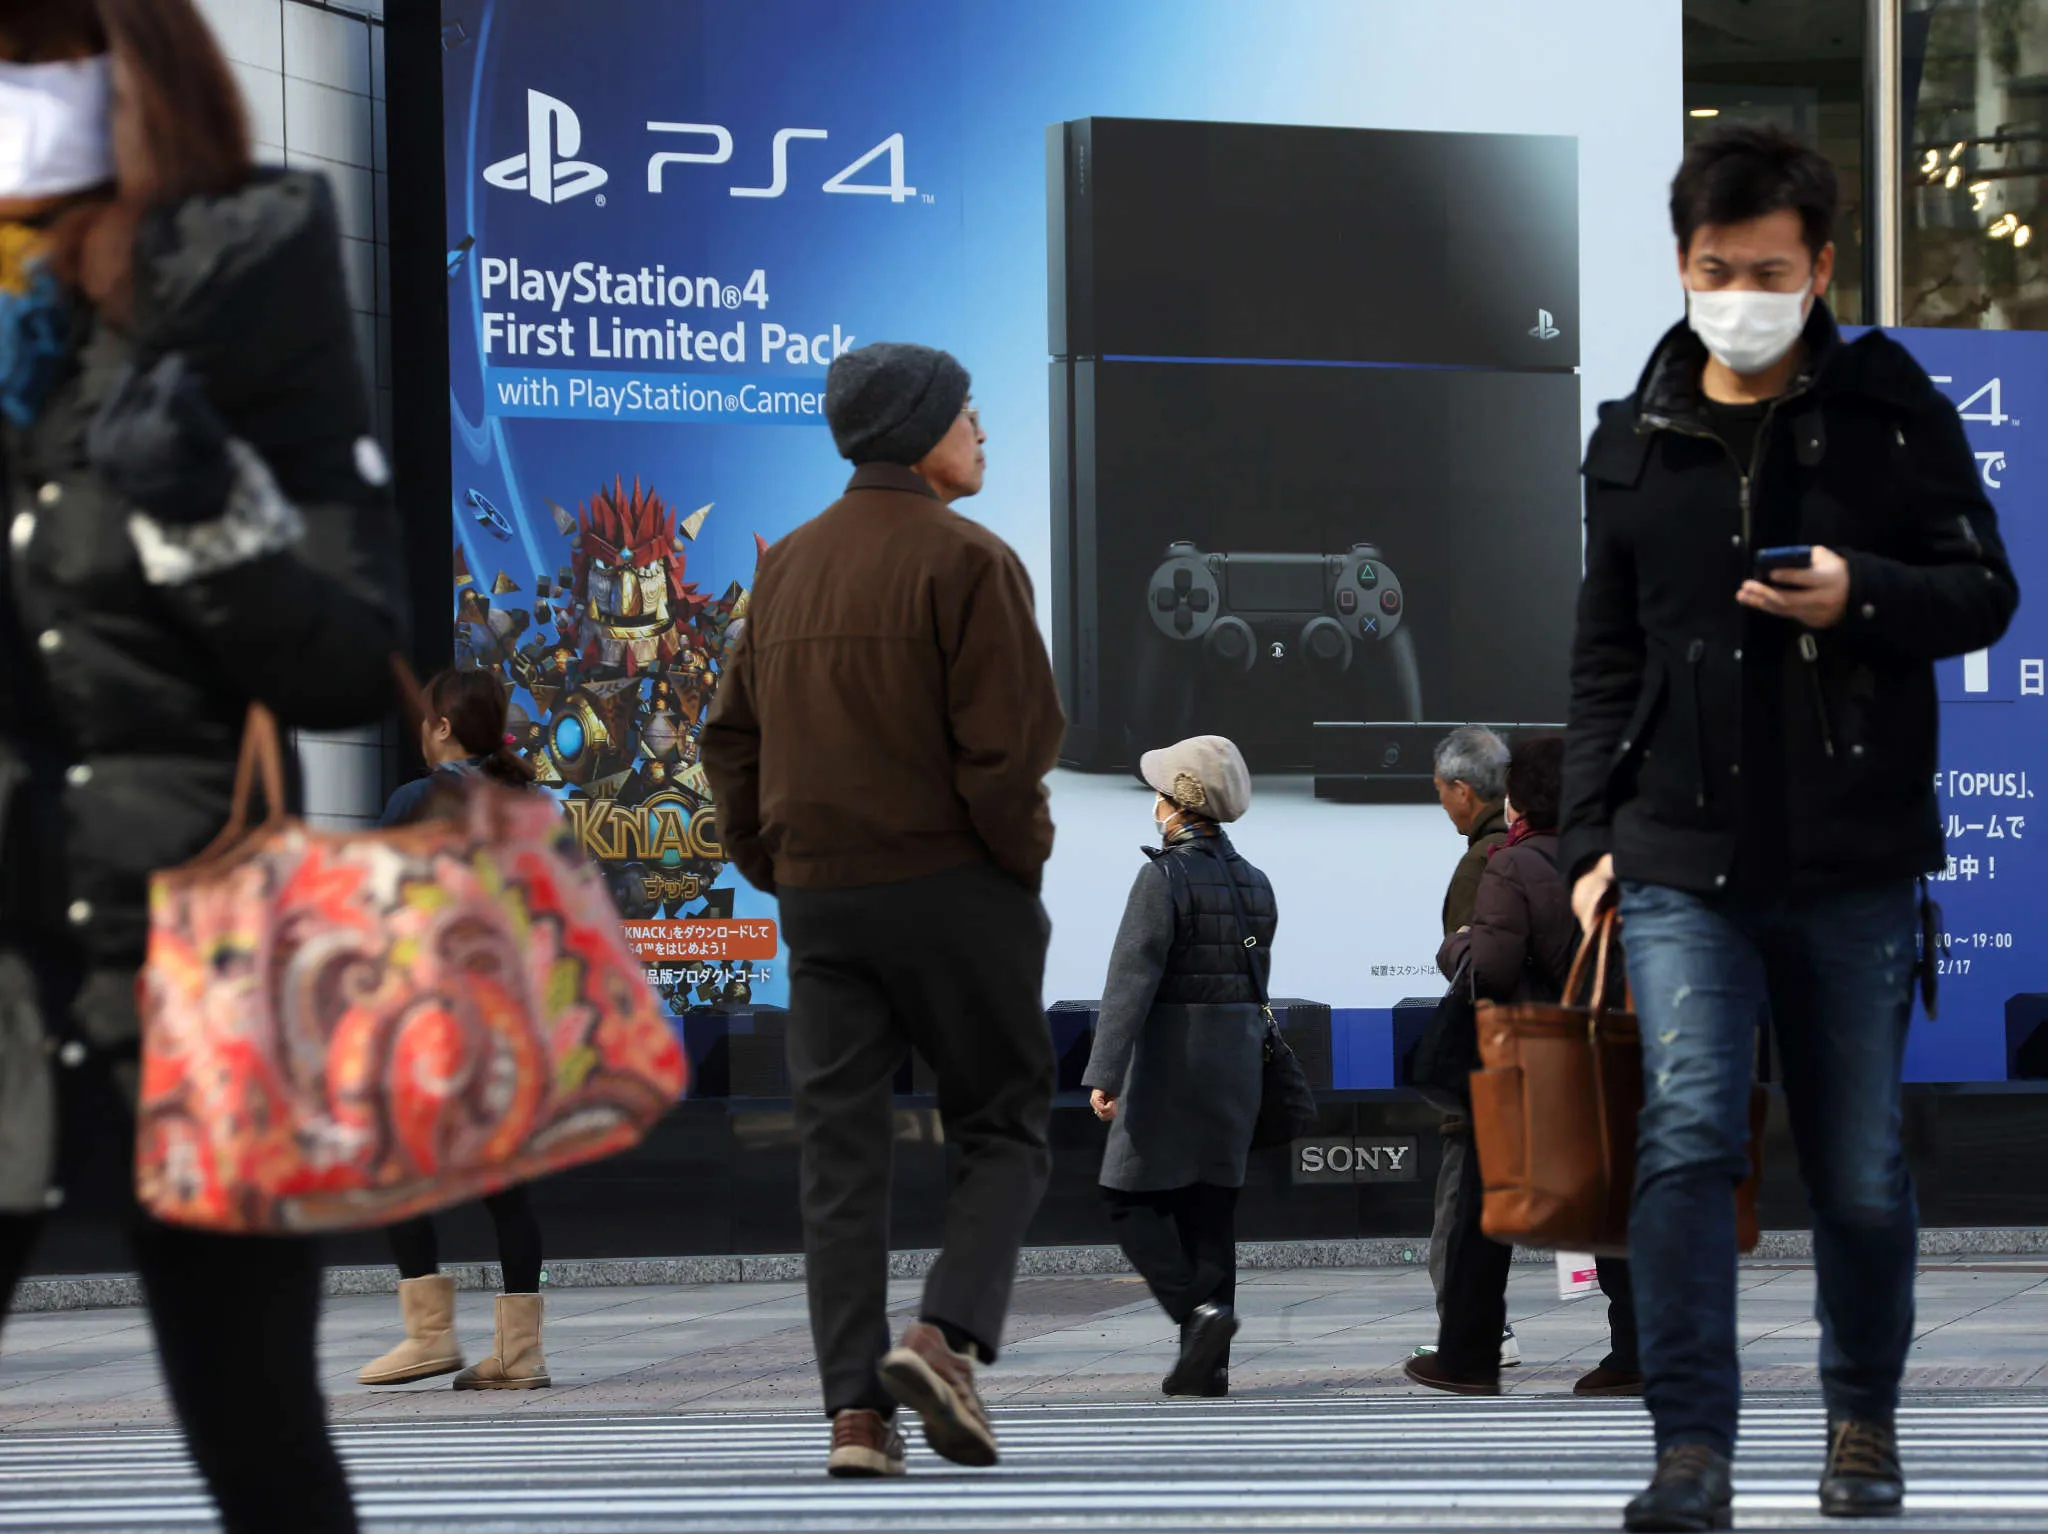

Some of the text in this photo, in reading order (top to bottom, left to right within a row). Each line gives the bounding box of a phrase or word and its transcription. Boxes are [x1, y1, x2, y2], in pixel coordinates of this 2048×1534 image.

[480, 257, 769, 312] PlayStation®4
[481, 312, 856, 366] First Limited Pack
[497, 377, 827, 416] with PlayStation®Camer
[1974, 451, 2007, 488] で
[2020, 658, 2045, 695] 日
[564, 799, 735, 860] KNAC
[1940, 814, 2026, 839] ルームで
[641, 872, 701, 900] ナック
[642, 967, 772, 986] 品版プロダクトコード
[1300, 1145, 1409, 1173] SONY
